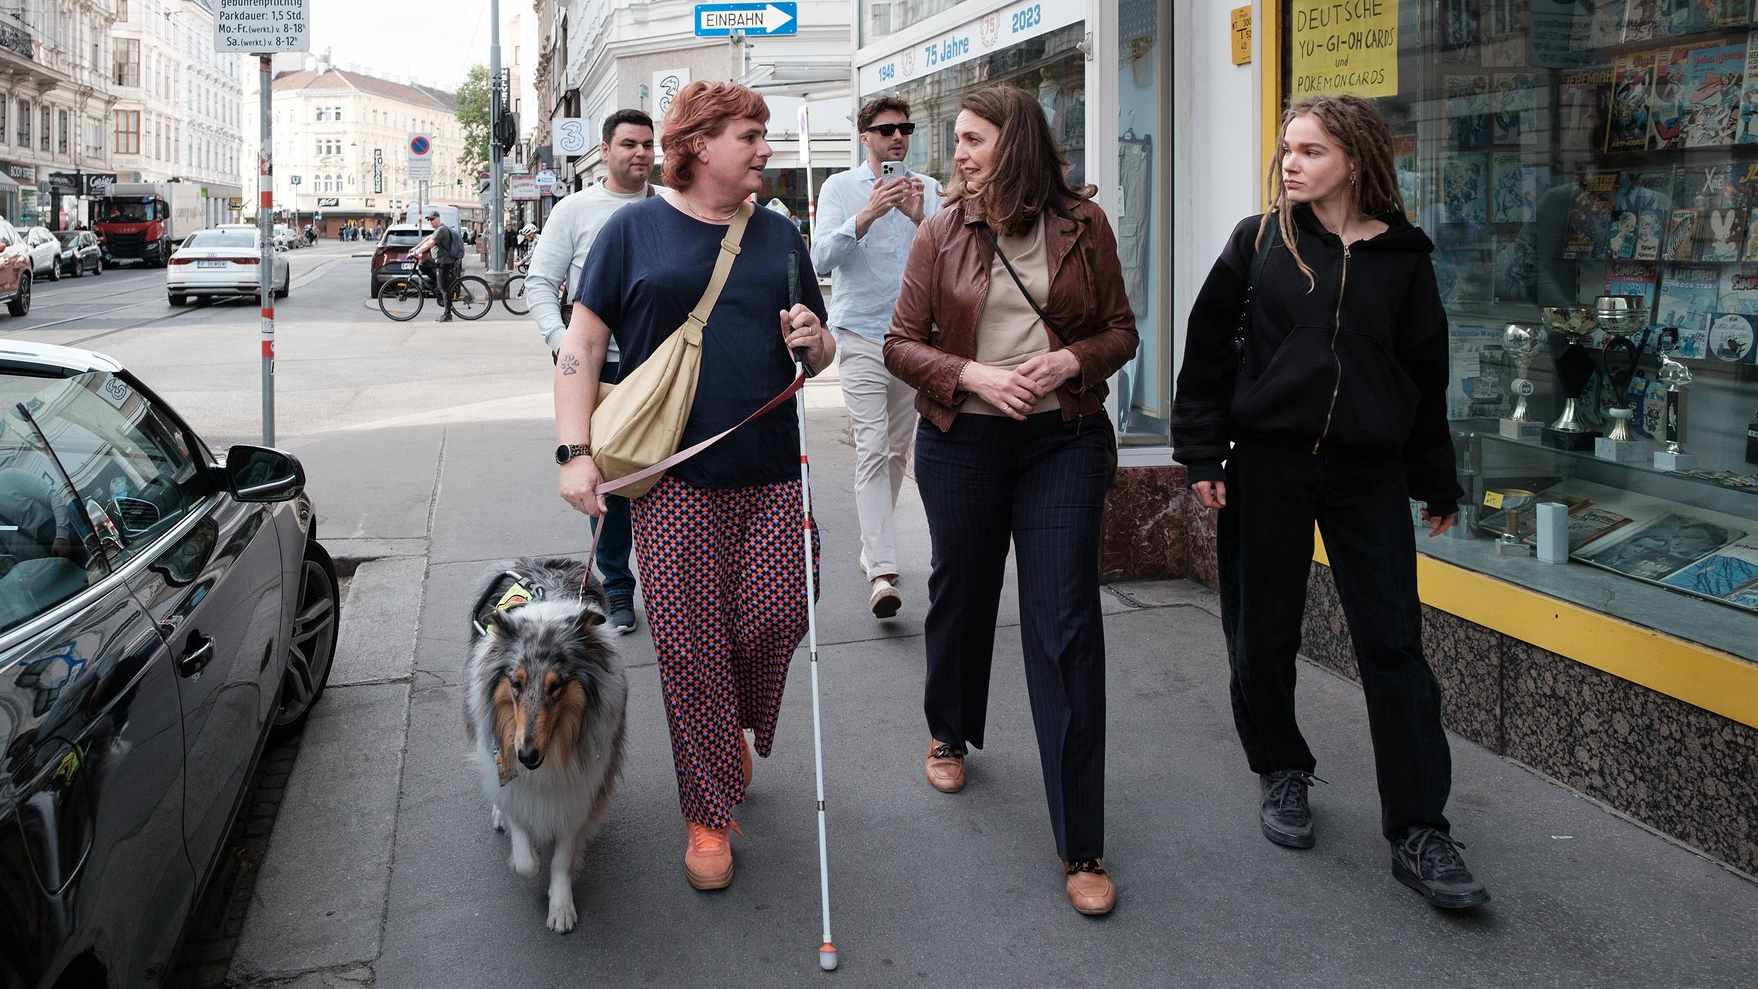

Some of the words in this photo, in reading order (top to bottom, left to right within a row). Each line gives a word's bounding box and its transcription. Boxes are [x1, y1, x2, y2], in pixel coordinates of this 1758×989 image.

[219, 11, 268, 20] Parkdauer:
[271, 11, 284, 21] 1,5
[287, 11, 304, 20] Std.
[706, 12, 764, 27] EINBAHN
[1297, 0, 1383, 33] DEUTSCHE
[218, 24, 248, 33] Mo.-Fr.
[248, 25, 274, 34] (werkt.)
[226, 37, 240, 46] Sa.
[240, 38, 267, 47] (werkt.)
[878, 62, 895, 82] 1948
[903, 51, 913, 66] 75
[925, 43, 937, 68] 75
[940, 36, 969, 63] Jahre
[984, 18, 995, 36] 75
[1012, 4, 1041, 34] 2023
[1365, 27, 1395, 49] CARDS
[1334, 54, 1350, 68] und
[560, 121, 584, 151] 3
